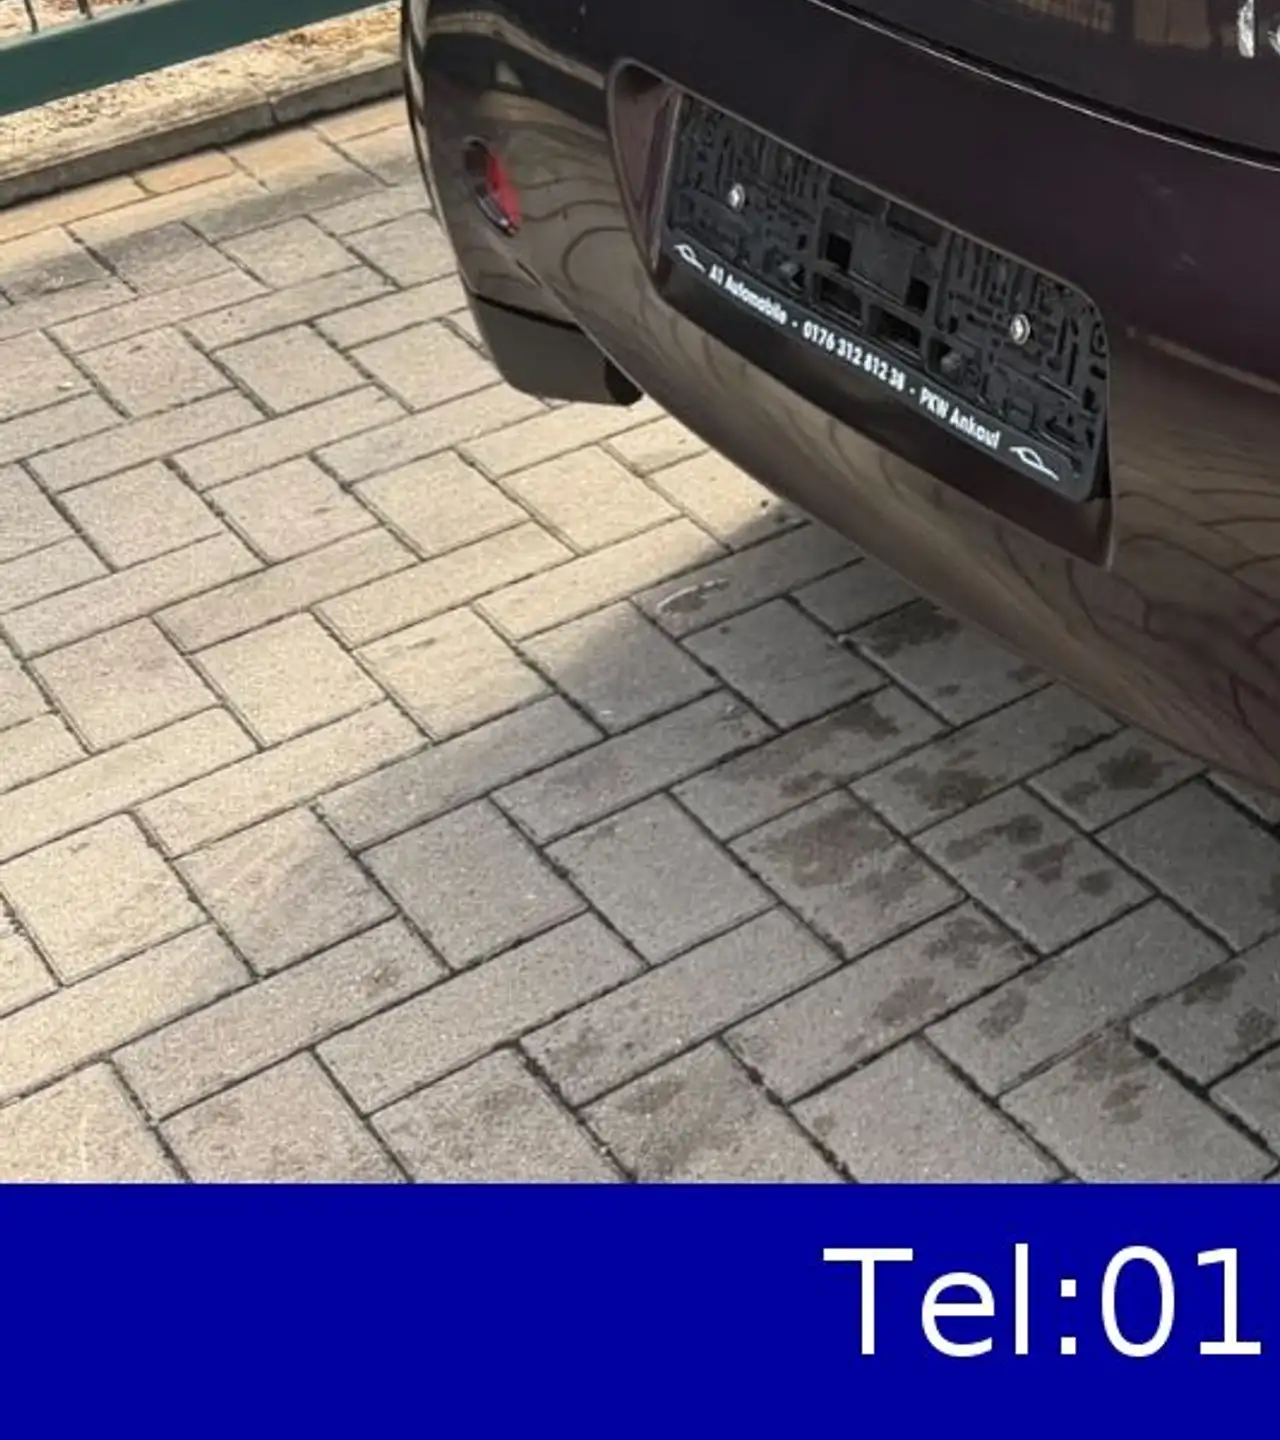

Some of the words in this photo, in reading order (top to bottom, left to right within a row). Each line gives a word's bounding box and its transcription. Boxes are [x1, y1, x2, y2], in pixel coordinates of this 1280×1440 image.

[723, 274, 788, 325] Automobile
[803, 320, 836, 352] 0176
[837, 337, 864, 366] 312
[919, 385, 950, 420] PKW
[948, 405, 1001, 450] Ankauf
